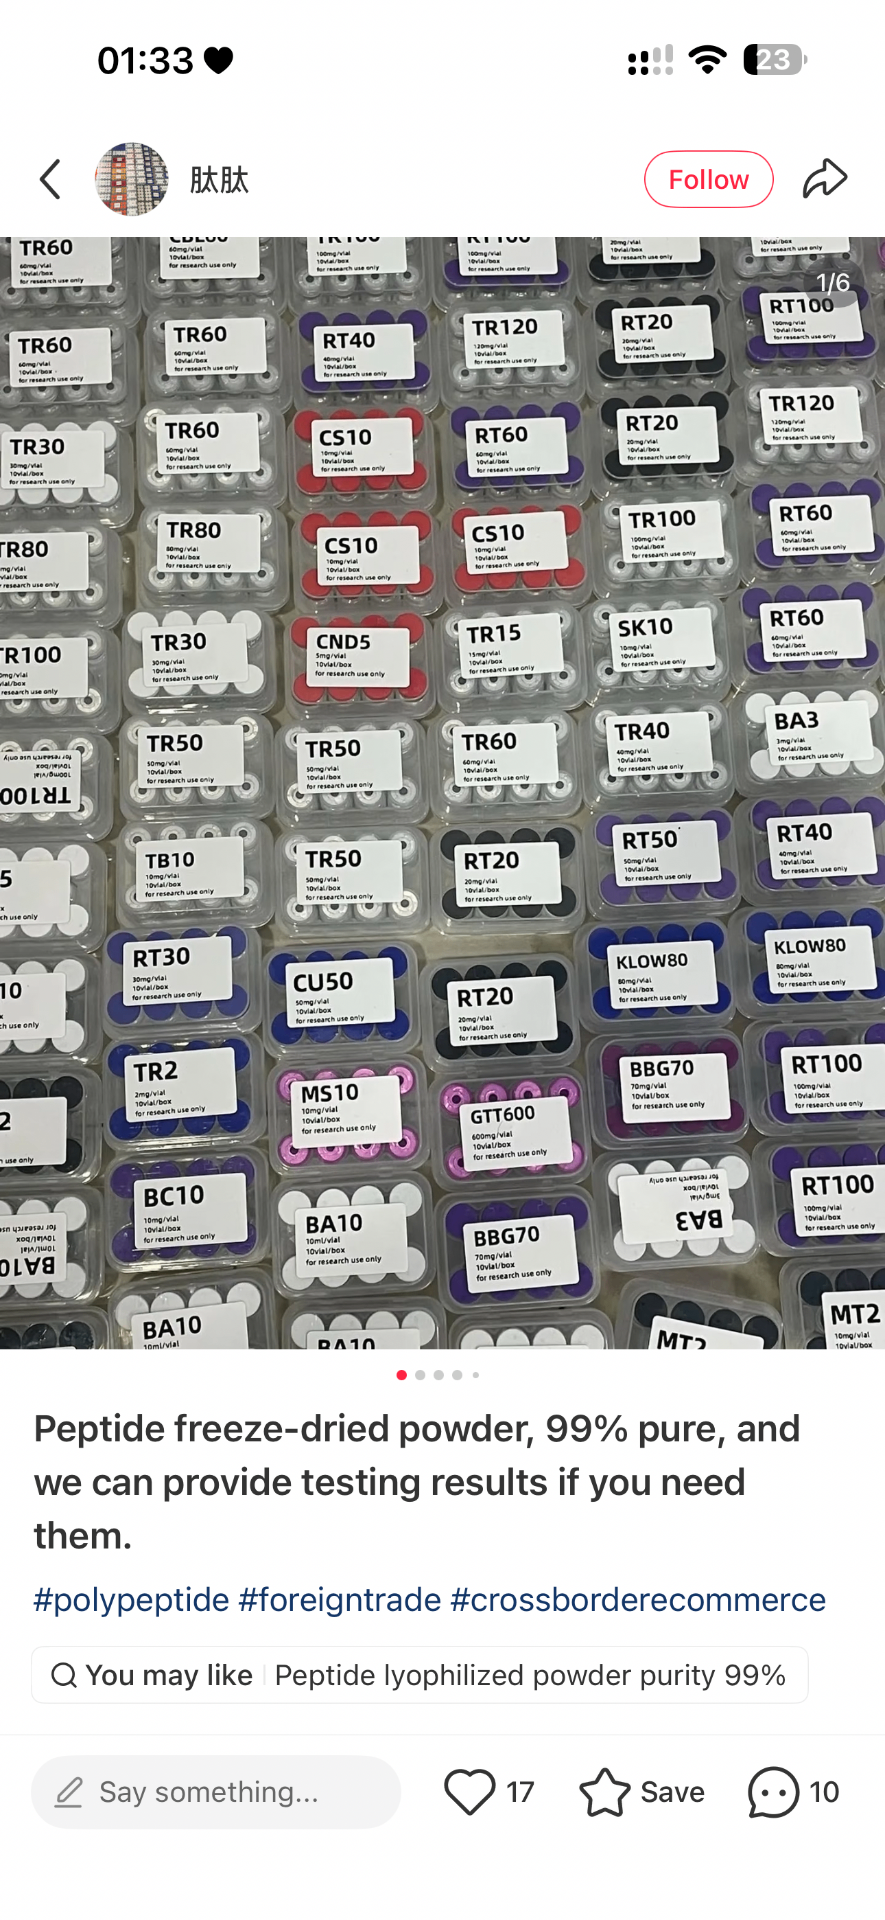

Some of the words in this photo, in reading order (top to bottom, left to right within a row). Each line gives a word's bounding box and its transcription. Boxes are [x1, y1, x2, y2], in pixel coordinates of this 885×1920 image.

[98, 47, 193, 74] 01:33
[757, 49, 790, 70] 23
[191, 166, 248, 193] 肽肽
[670, 169, 749, 189] Follow
[20, 239, 72, 256] TR60
[770, 298, 834, 313] RT100
[472, 319, 537, 335] TR120
[622, 314, 672, 330] RT20
[174, 326, 226, 342] TR60
[324, 332, 375, 349] RT40
[18, 337, 71, 354] TR60
[769, 395, 834, 411] TR120
[165, 422, 219, 439] TR60
[627, 415, 678, 431] RT20
[320, 429, 371, 446] CS10
[476, 426, 527, 443] RT60
[10, 439, 64, 455] TR30
[9, 462, 43, 470] 30mg/vial
[60, 478, 76, 486] only
[628, 510, 695, 528] TR100
[780, 505, 832, 522] RT60
[167, 522, 221, 538] TR80
[473, 524, 524, 542] CS10
[165, 545, 199, 554] 80mg/vial
[325, 538, 377, 554] CS10
[771, 609, 823, 627] RT60
[467, 624, 520, 643] TR15
[619, 618, 672, 637] SK10
[151, 633, 206, 651] TR30
[317, 635, 370, 649] CND5
[0, 646, 61, 663] R100
[315, 652, 347, 661] 5mg/vial
[369, 671, 386, 679] only
[775, 712, 818, 729] BA3
[615, 722, 669, 740] TR40
[147, 734, 202, 752] TR50
[305, 740, 360, 758] TR50
[462, 733, 516, 750] TR60
[623, 830, 677, 849] RT50
[778, 823, 832, 842] RT40
[145, 852, 194, 868] TB10
[305, 850, 361, 868] TR50
[465, 852, 519, 869] RT20
[623, 857, 657, 866] 50mg/vial
[624, 865, 660, 873] 10vial/box
[635, 874, 664, 882] research
[676, 873, 692, 881] only
[775, 939, 845, 954] KLOW80
[134, 947, 189, 967] RT30
[617, 953, 687, 969] KLOW80
[294, 972, 352, 992] CU50
[458, 987, 513, 1007] RT20
[134, 1061, 177, 1082] TR2
[631, 1060, 693, 1077] BBG70
[792, 1054, 862, 1074] RT100
[302, 1084, 358, 1103] MS10
[301, 1105, 339, 1116] 10mg/vial
[471, 1106, 534, 1124] GTT600
[301, 1116, 341, 1125] 10vial/box
[301, 1127, 313, 1135] for
[313, 1125, 345, 1134] research
[359, 1123, 377, 1132] only
[471, 1130, 513, 1141] 600mg/vial
[472, 1141, 512, 1151] 10vial/box
[472, 1153, 484, 1161] for
[485, 1150, 516, 1160] research
[517, 1150, 530, 1158] use
[531, 1148, 548, 1157] only
[802, 1175, 874, 1195] RT100
[145, 1185, 203, 1207] BC10
[803, 1203, 843, 1213] 100mg/vial
[143, 1215, 180, 1225] 10mg/vial
[307, 1214, 362, 1233] BA10
[676, 1210, 722, 1231] BA3
[804, 1214, 842, 1222] 10vial/box
[143, 1225, 182, 1234] 10vial/box
[143, 1236, 154, 1244] for
[154, 1234, 185, 1243] research
[199, 1232, 216, 1241] only
[475, 1226, 539, 1247] BBG70
[305, 1235, 341, 1245] 10ml/vial
[305, 1247, 346, 1256] 10vial/box
[474, 1250, 513, 1262] 70mg/vial
[305, 1258, 317, 1266] for
[318, 1256, 350, 1266] research
[365, 1255, 382, 1264] only
[475, 1261, 516, 1272] 10vial/box
[475, 1274, 487, 1282] for
[488, 1271, 520, 1281] research
[535, 1268, 552, 1277] only
[831, 1304, 880, 1325] MT2
[144, 1316, 201, 1339] BA10
[834, 1331, 870, 1341] 10mg/vial
[835, 1341, 873, 1349] 10vial/box
[36, 1413, 164, 1448] Peptide
[174, 1413, 388, 1442] freeze-dried
[401, 1414, 533, 1448] powder,
[547, 1415, 627, 1442] 99%
[640, 1421, 724, 1448] pure,
[738, 1414, 799, 1442] and
[34, 1475, 81, 1495] we
[93, 1475, 152, 1495] can
[165, 1467, 291, 1502] provide
[301, 1467, 419, 1502] testing
[433, 1467, 547, 1495] results
[559, 1467, 579, 1495] if
[589, 1475, 650, 1502] you
[663, 1467, 744, 1495] need
[34, 1521, 130, 1549] them.
[34, 1586, 228, 1617] #polypeptide
[239, 1586, 440, 1617] #foreigntrade
[451, 1587, 825, 1611] #crossborderecommerce
[86, 1665, 133, 1685] You
[144, 1669, 198, 1691] may
[209, 1663, 252, 1685] like
[277, 1664, 375, 1690] Peptide
[386, 1664, 522, 1691] lyophilized
[534, 1664, 631, 1690] powder
[642, 1664, 715, 1691] purity
[726, 1664, 785, 1686] 99%
[101, 1781, 146, 1807] Say
[156, 1780, 317, 1807] something...
[507, 1781, 534, 1802] 17
[642, 1781, 704, 1803] Save
[811, 1781, 839, 1802] 10
